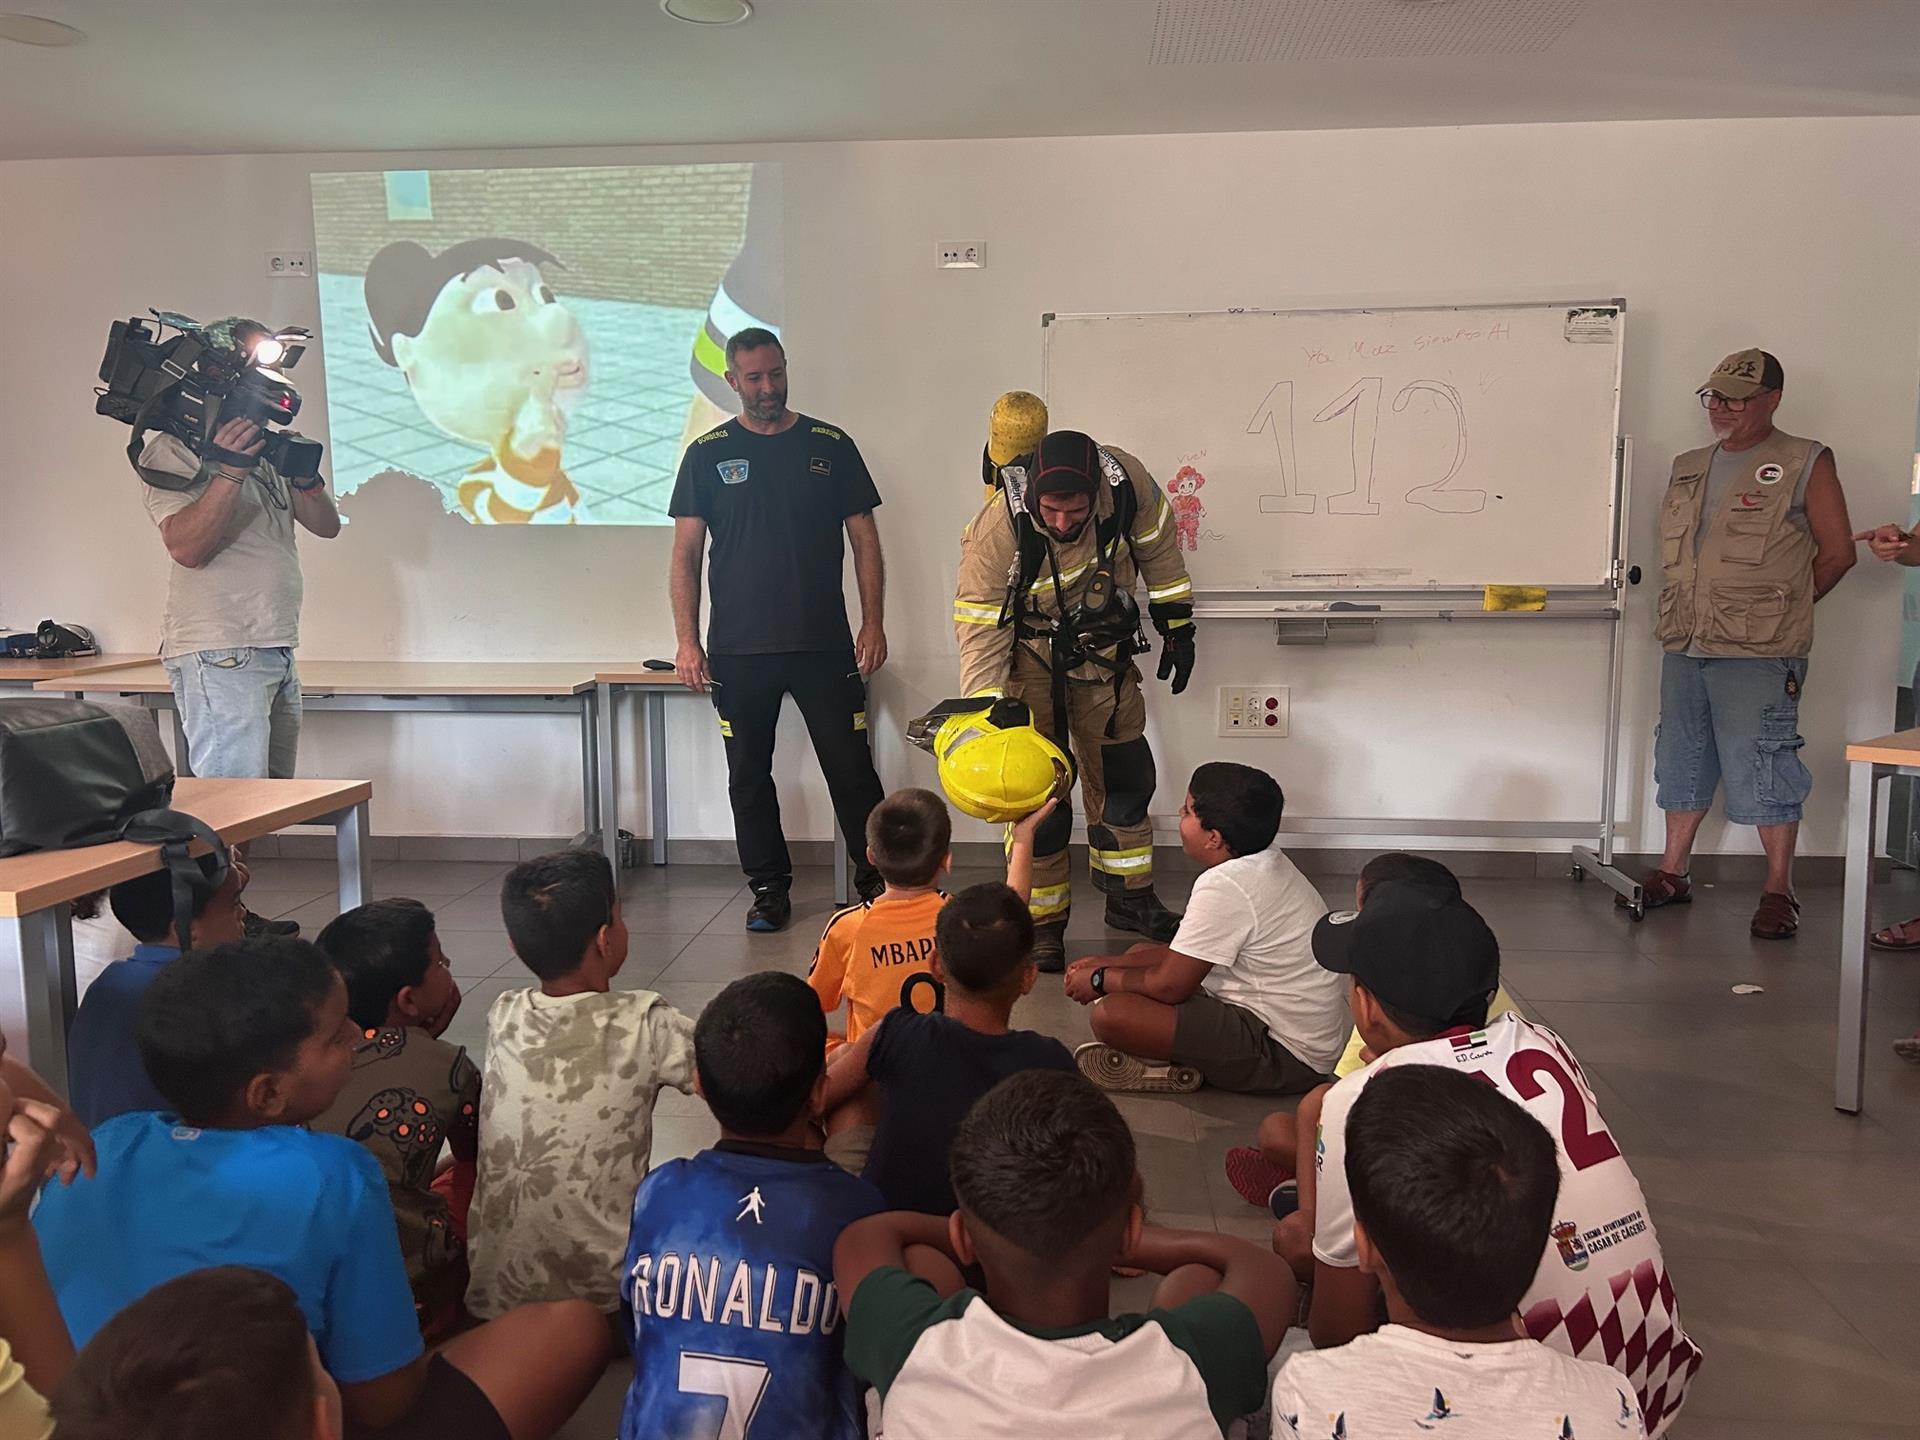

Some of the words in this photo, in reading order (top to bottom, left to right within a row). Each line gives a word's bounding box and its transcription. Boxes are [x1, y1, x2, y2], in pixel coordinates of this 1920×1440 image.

[1246, 376, 1487, 516] 112
[870, 936, 938, 969] MBAP
[1587, 1236, 1613, 1255] CASAR
[1611, 1231, 1622, 1245] DE
[631, 1252, 840, 1336] RONALDO
[678, 1350, 772, 1440] 7
